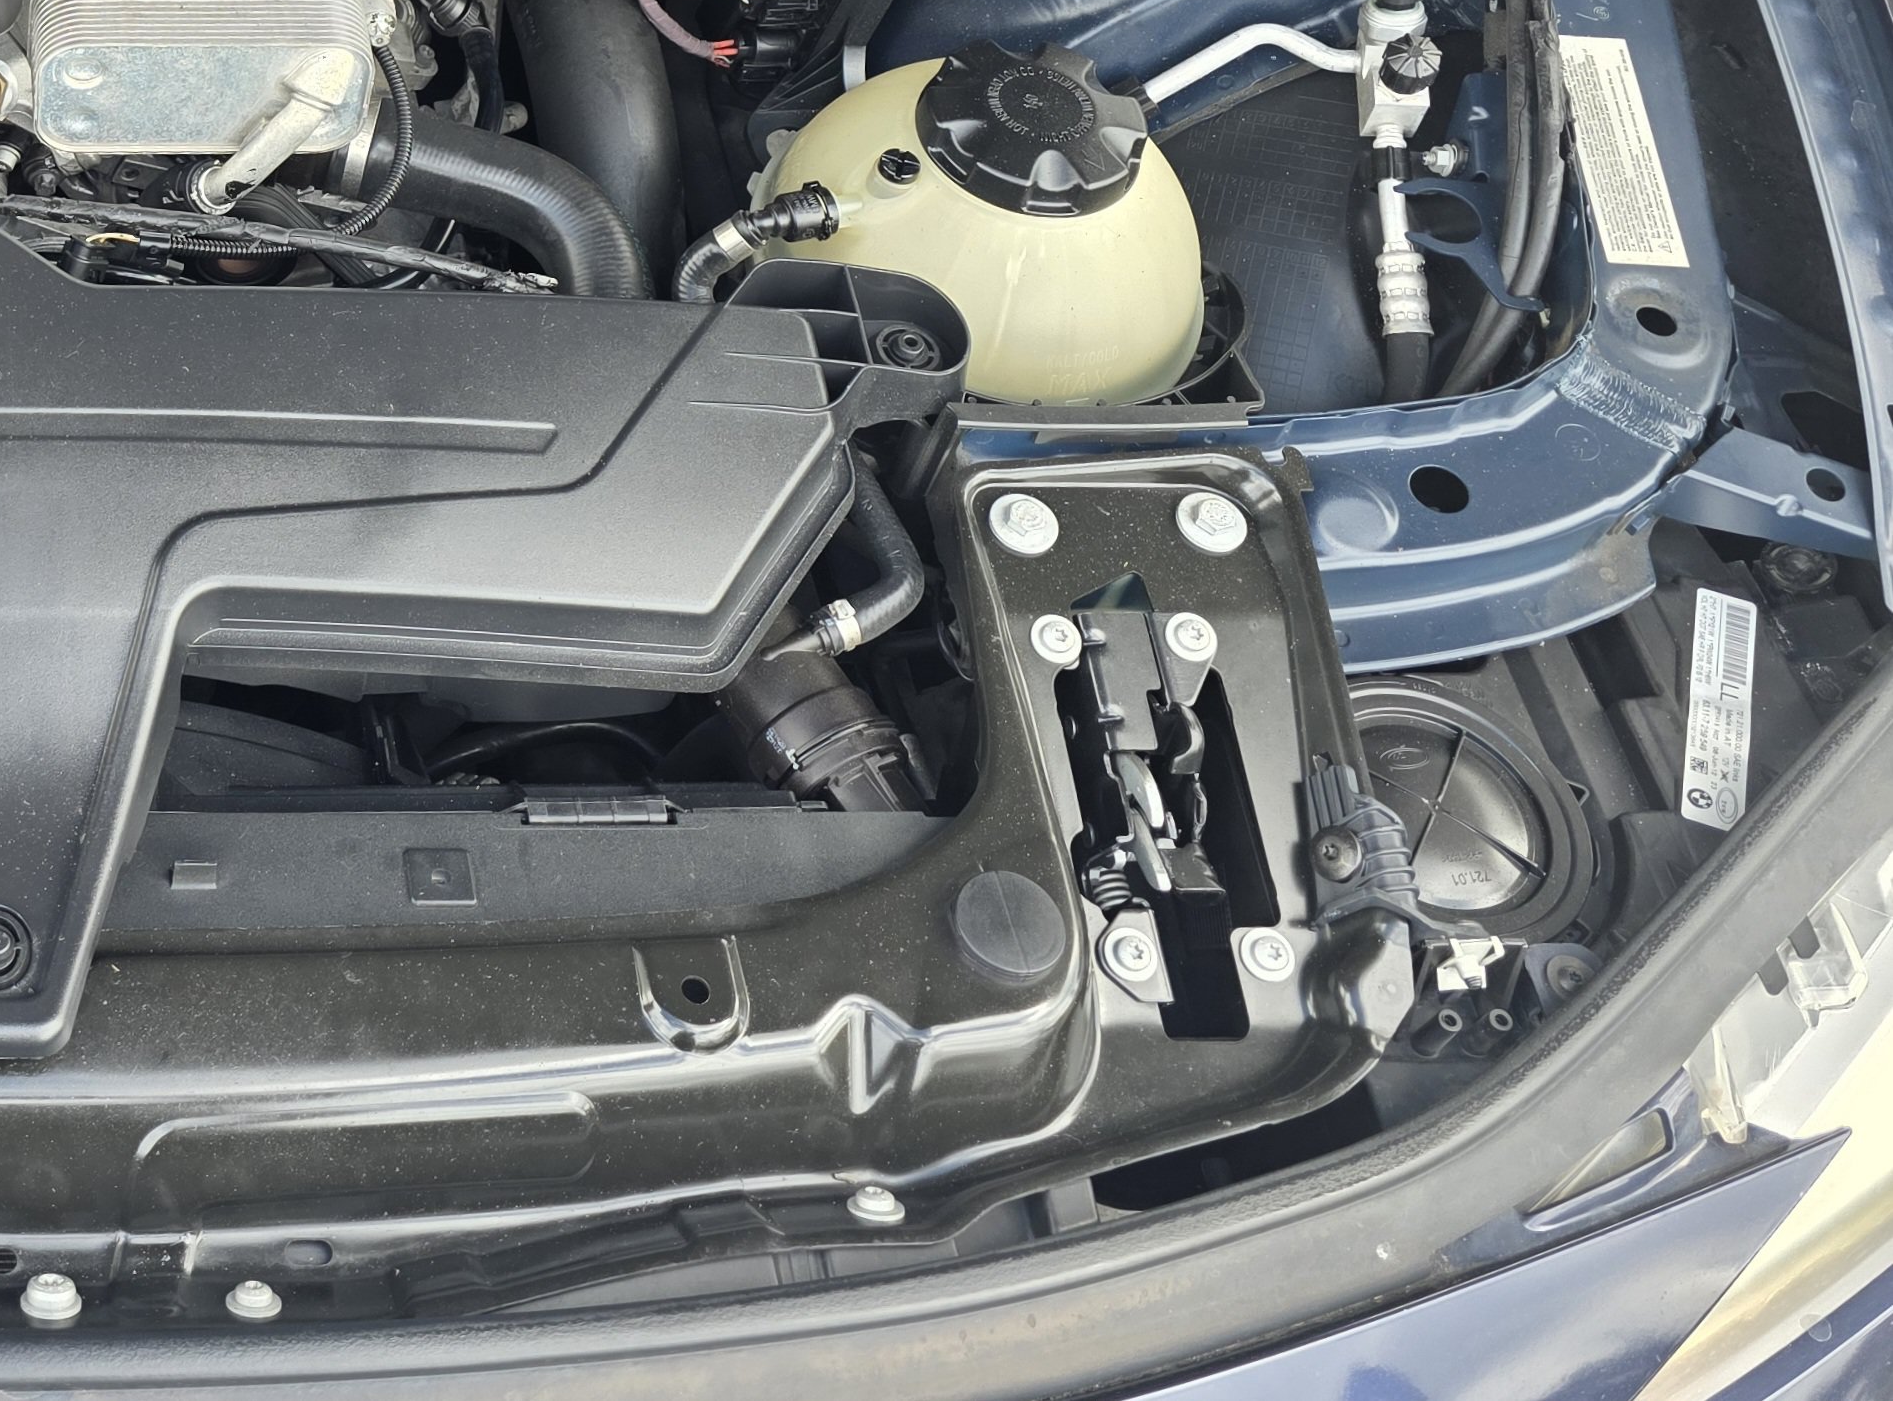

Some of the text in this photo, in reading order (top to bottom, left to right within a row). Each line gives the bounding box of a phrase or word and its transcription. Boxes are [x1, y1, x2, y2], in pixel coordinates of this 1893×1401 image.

[1719, 682, 1739, 703] LL
[1724, 708, 1732, 726] Made
[1450, 869, 1491, 886] 721.01
